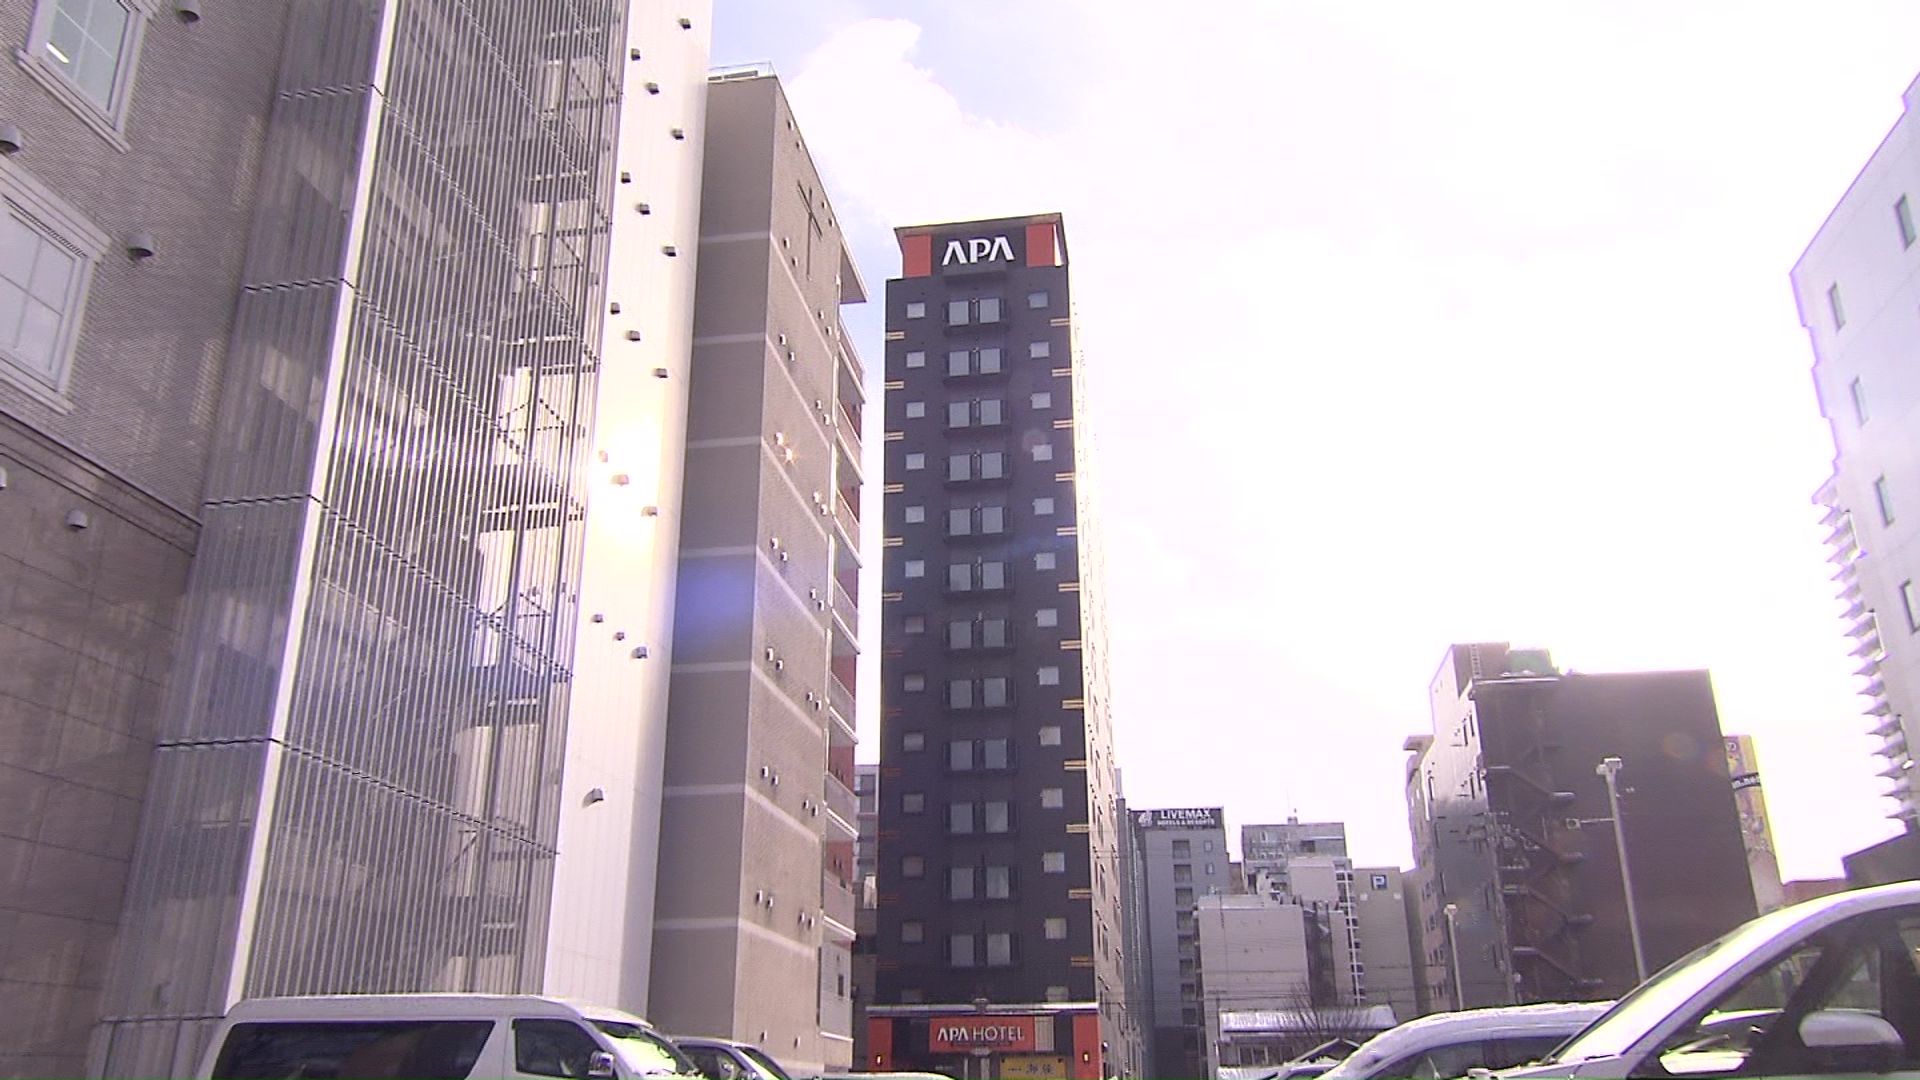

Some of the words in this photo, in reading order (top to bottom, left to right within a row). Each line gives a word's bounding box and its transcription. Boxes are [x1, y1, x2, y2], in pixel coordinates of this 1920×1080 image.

[942, 236, 1015, 266] APA
[1161, 808, 1210, 819] LIVEMAX
[1372, 876, 1385, 890] P
[937, 1026, 969, 1041] APA
[972, 1025, 1025, 1041] HOTEL
